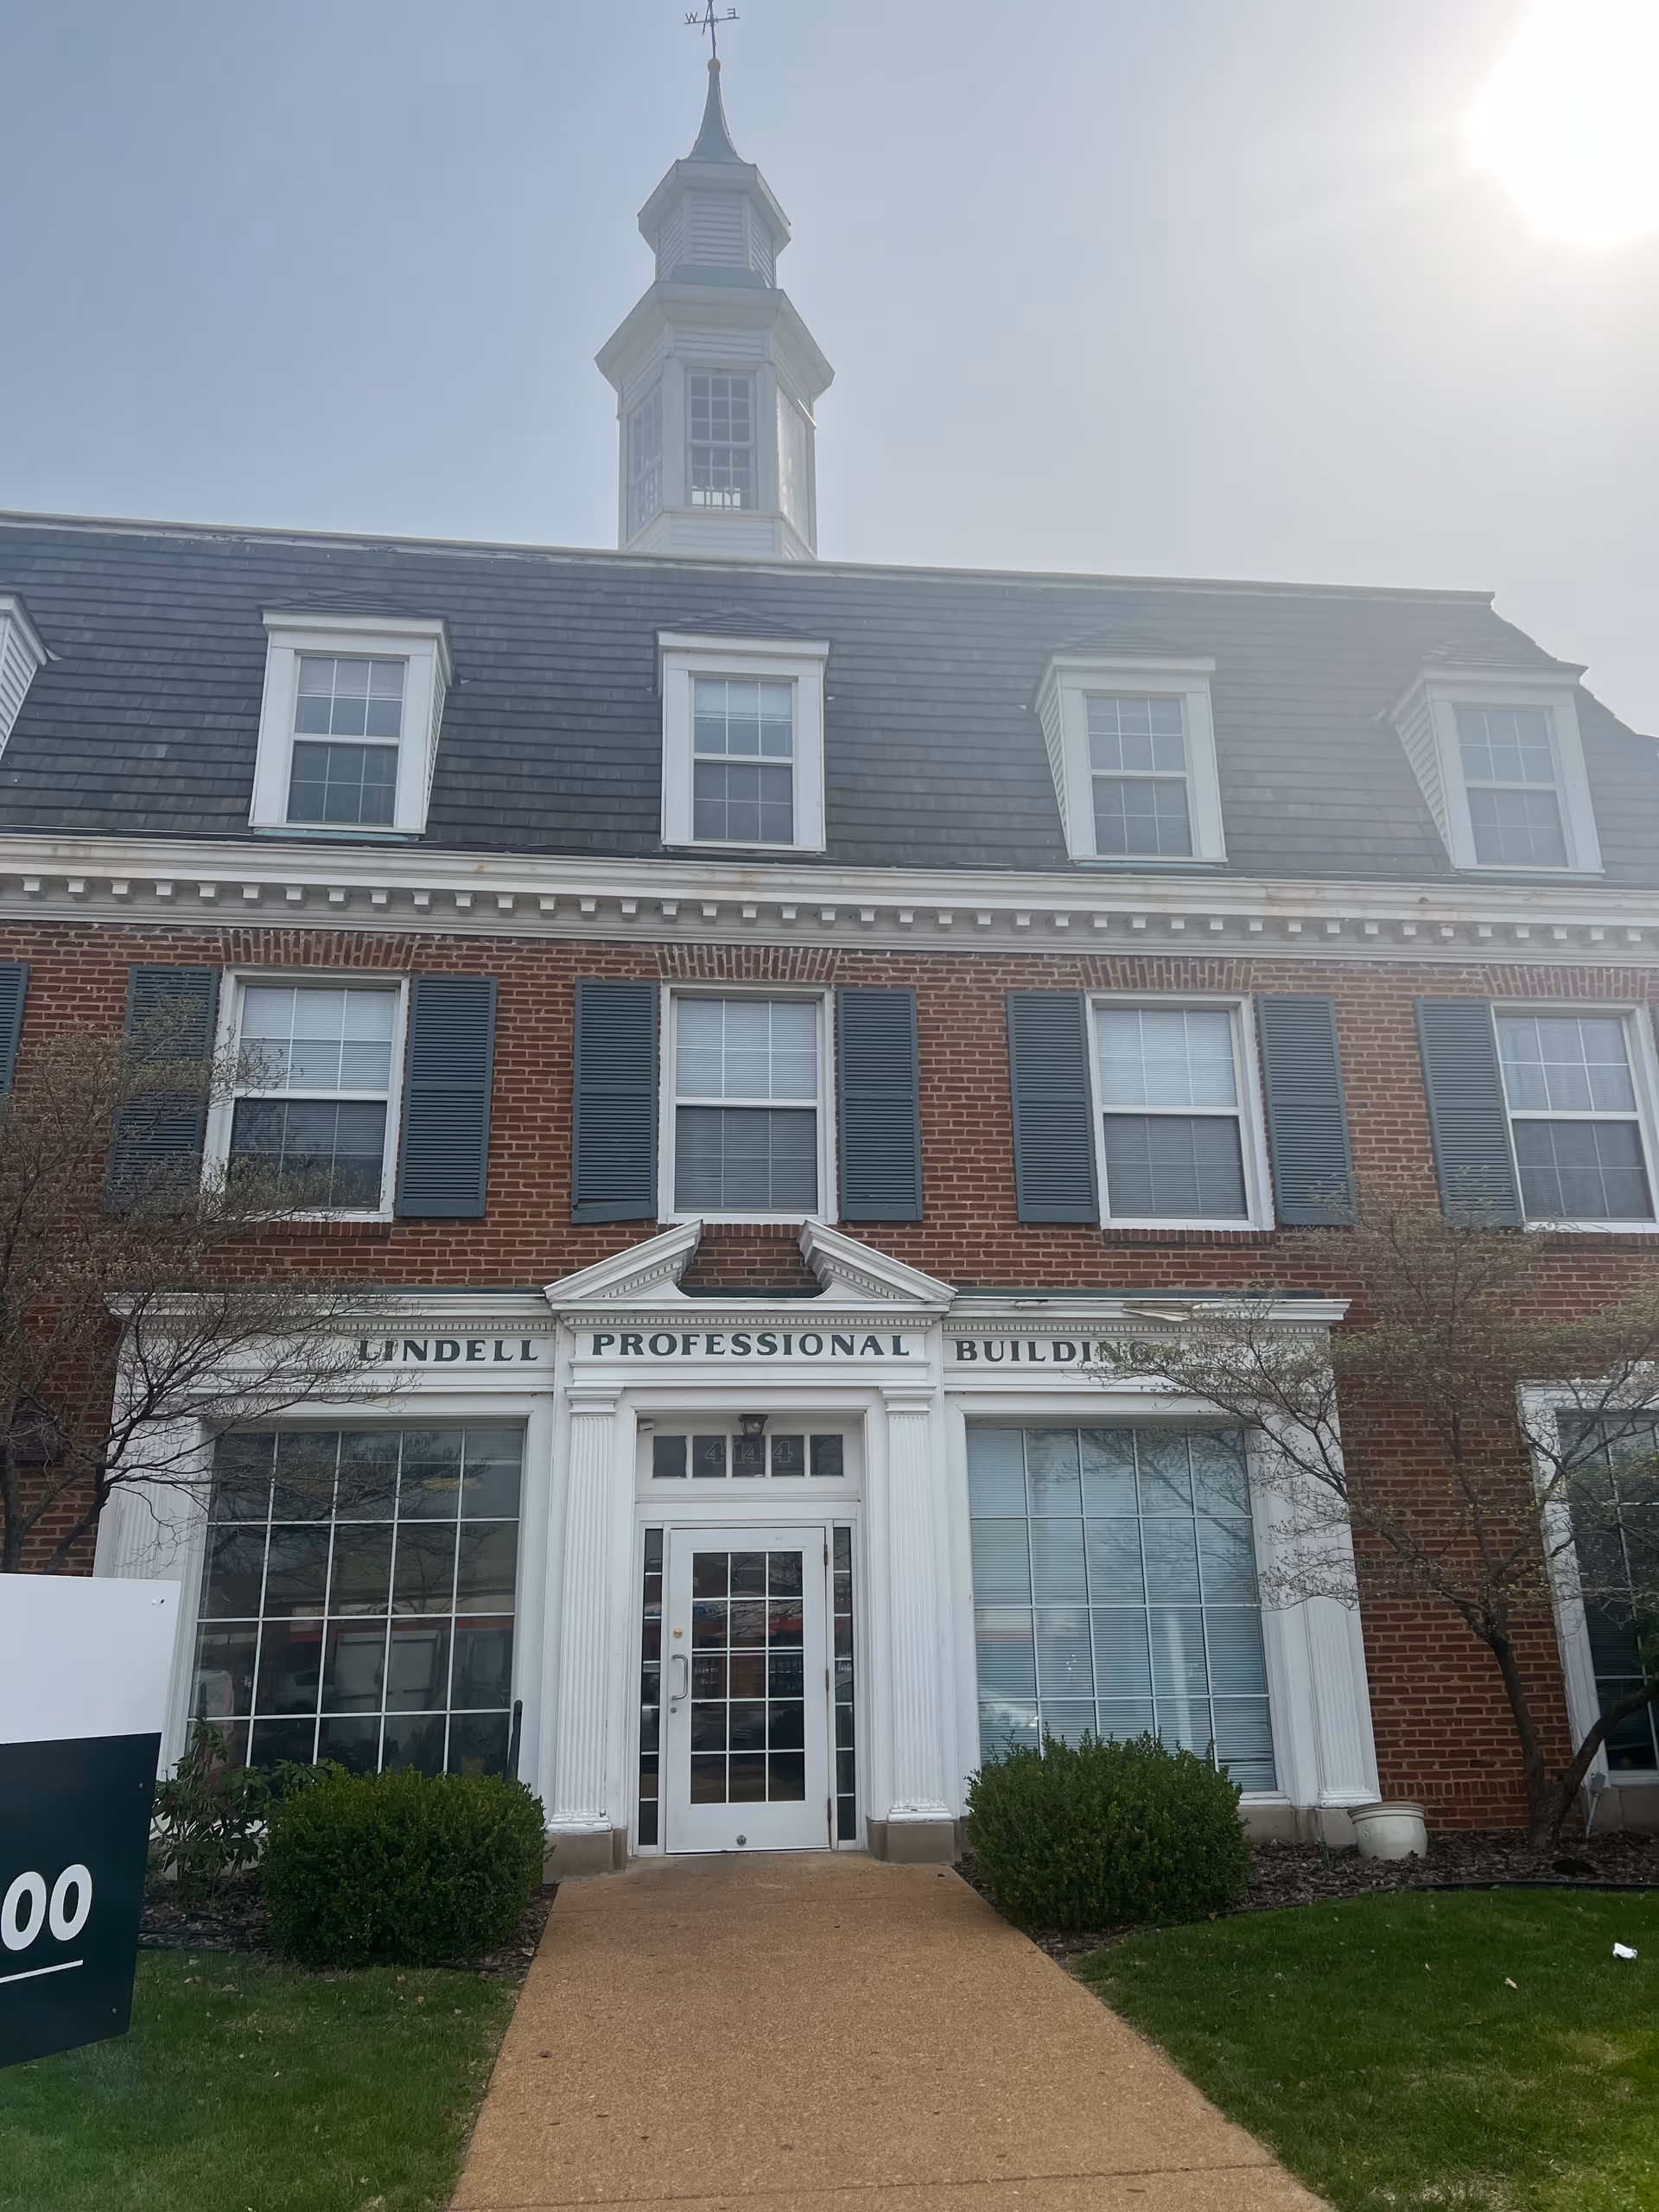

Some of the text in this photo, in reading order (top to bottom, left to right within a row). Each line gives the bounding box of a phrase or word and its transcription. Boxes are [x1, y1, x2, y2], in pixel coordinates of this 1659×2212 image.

[685, 11, 697, 23] W
[359, 1339, 539, 1362] LINDELL
[592, 1332, 910, 1357] PROFESSIONAL
[704, 1440, 793, 1464] 4144
[1, 1864, 92, 1951] 00
